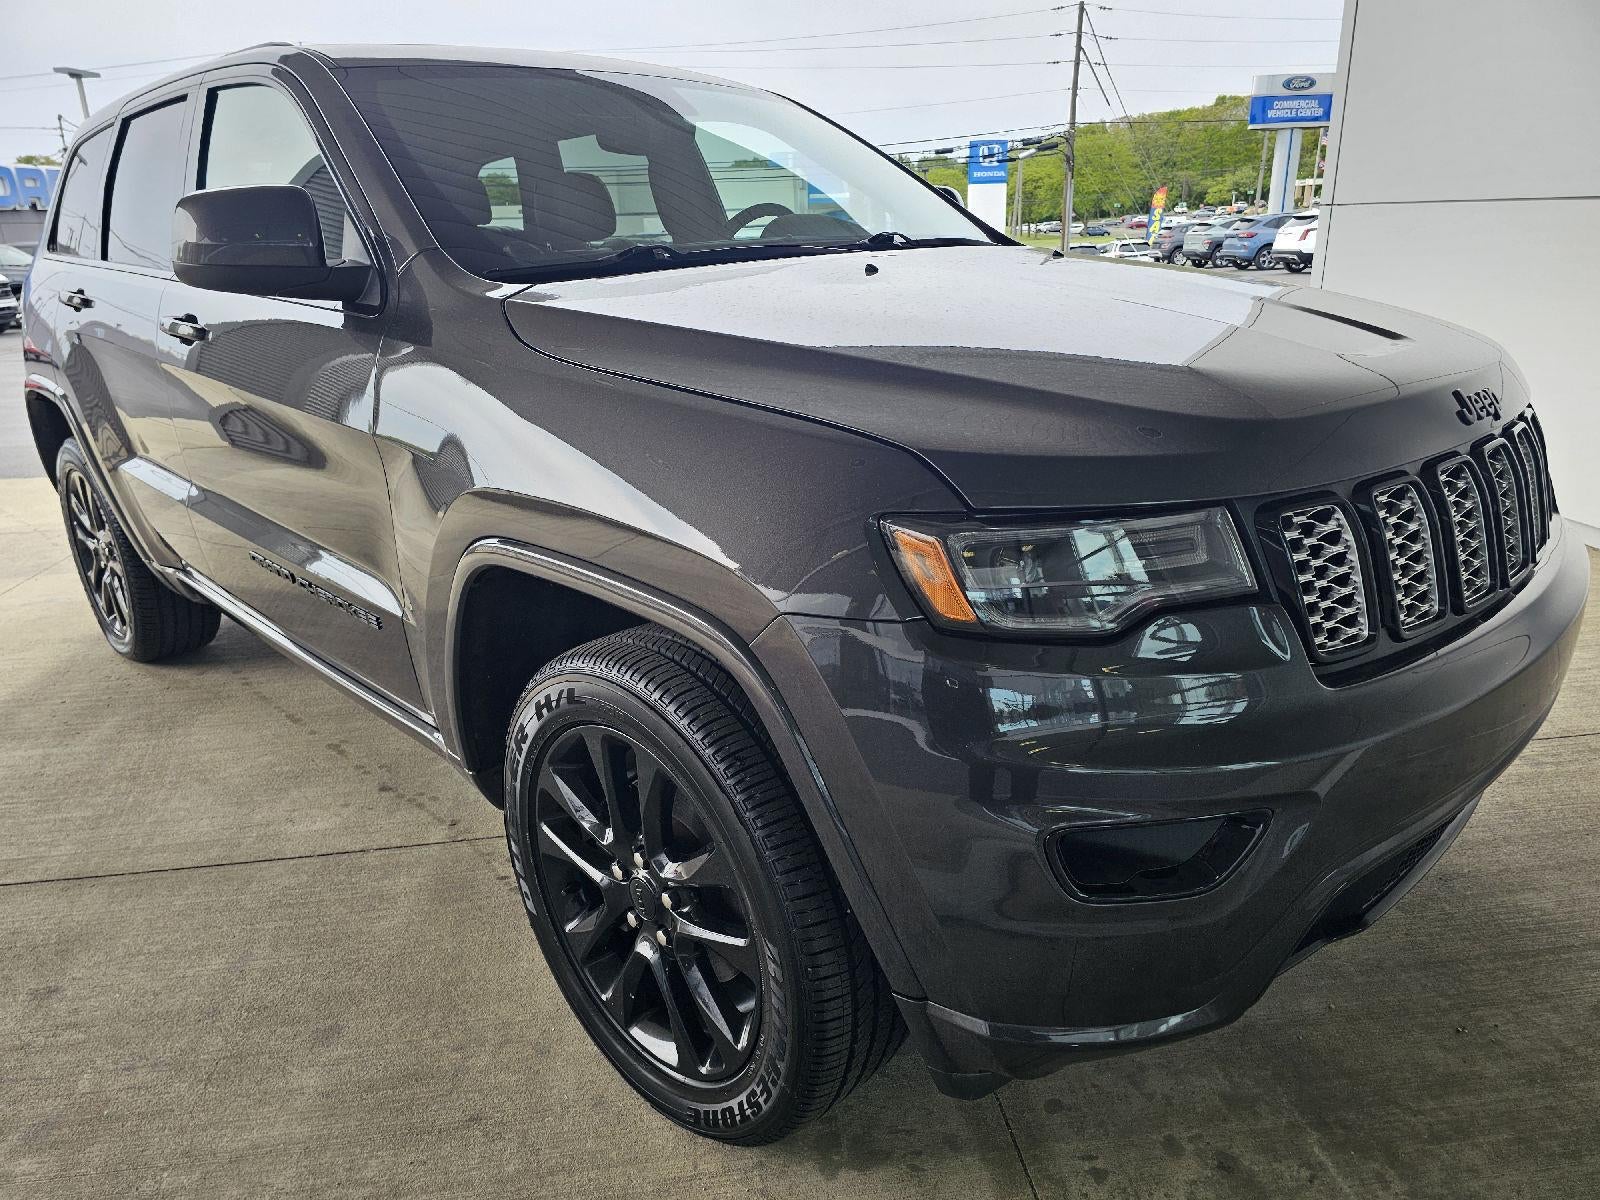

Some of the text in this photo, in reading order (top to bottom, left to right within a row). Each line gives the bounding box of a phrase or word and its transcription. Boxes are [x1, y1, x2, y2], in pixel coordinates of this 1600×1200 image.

[1289, 79, 1311, 88] Ford
[1267, 107, 1323, 118] VEHICLE CENTER
[1273, 100, 1320, 109] COMMERCIAL
[1452, 388, 1502, 426] Jeep
[297, 577, 383, 631] CHEROKEE
[535, 687, 587, 722] H/L
